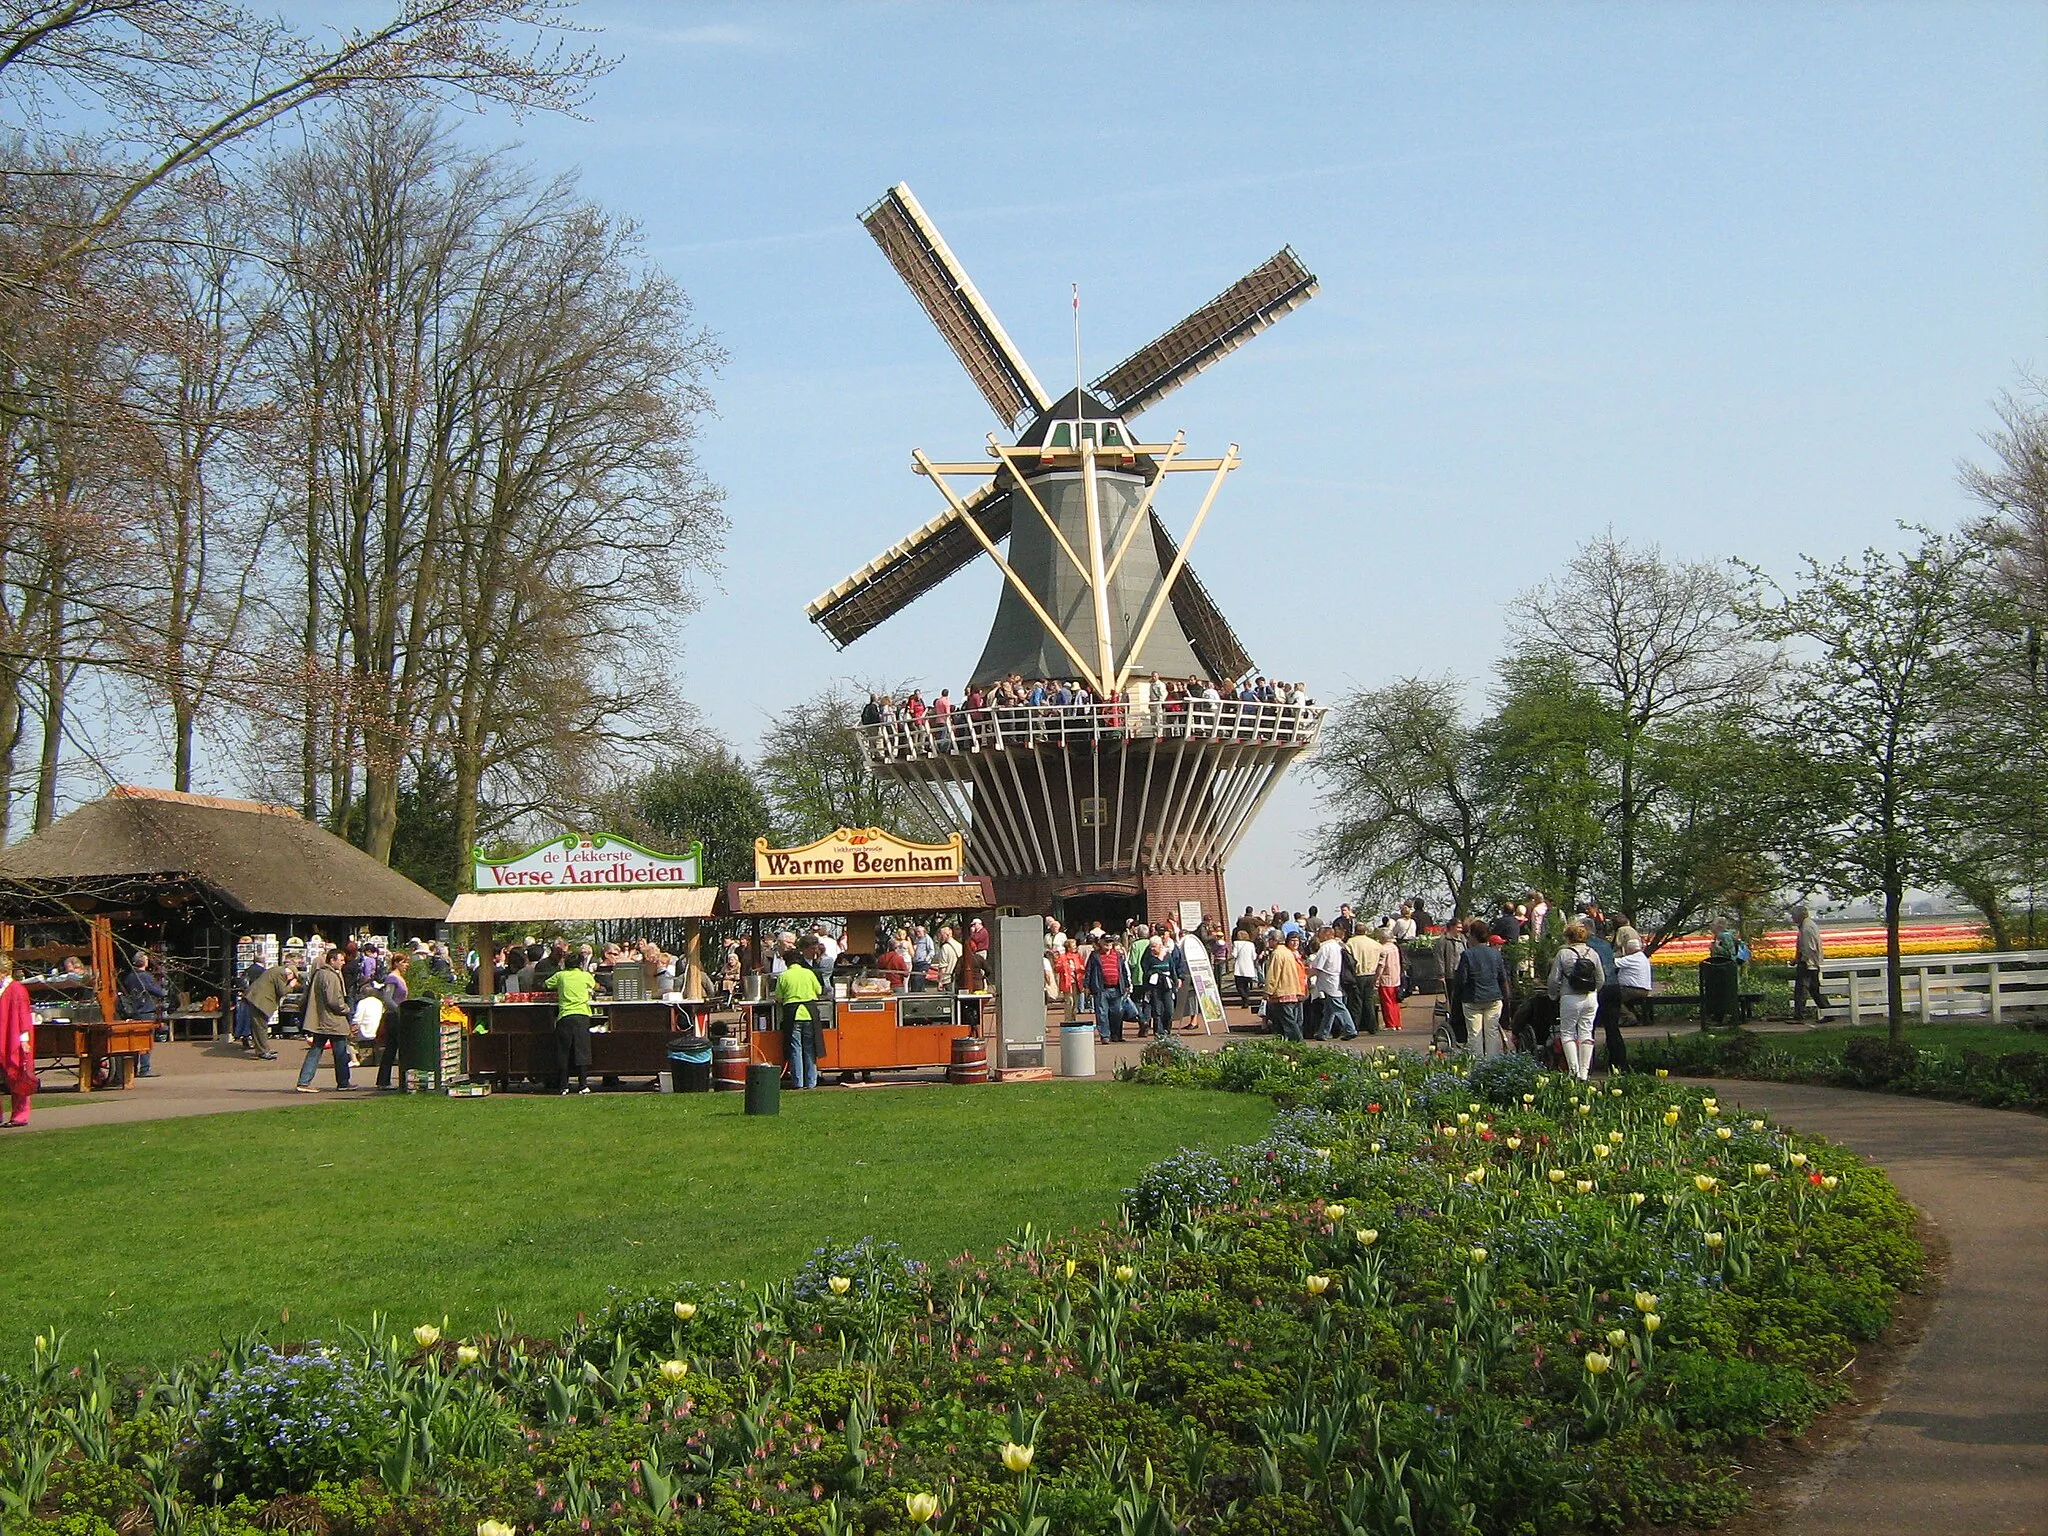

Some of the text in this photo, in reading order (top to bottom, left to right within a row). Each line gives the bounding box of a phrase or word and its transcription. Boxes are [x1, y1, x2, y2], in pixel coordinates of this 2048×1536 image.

[543, 850, 632, 863] de Lekkerste
[768, 852, 952, 875] Warme Beenham
[491, 862, 685, 886] Verse Aardbeien
